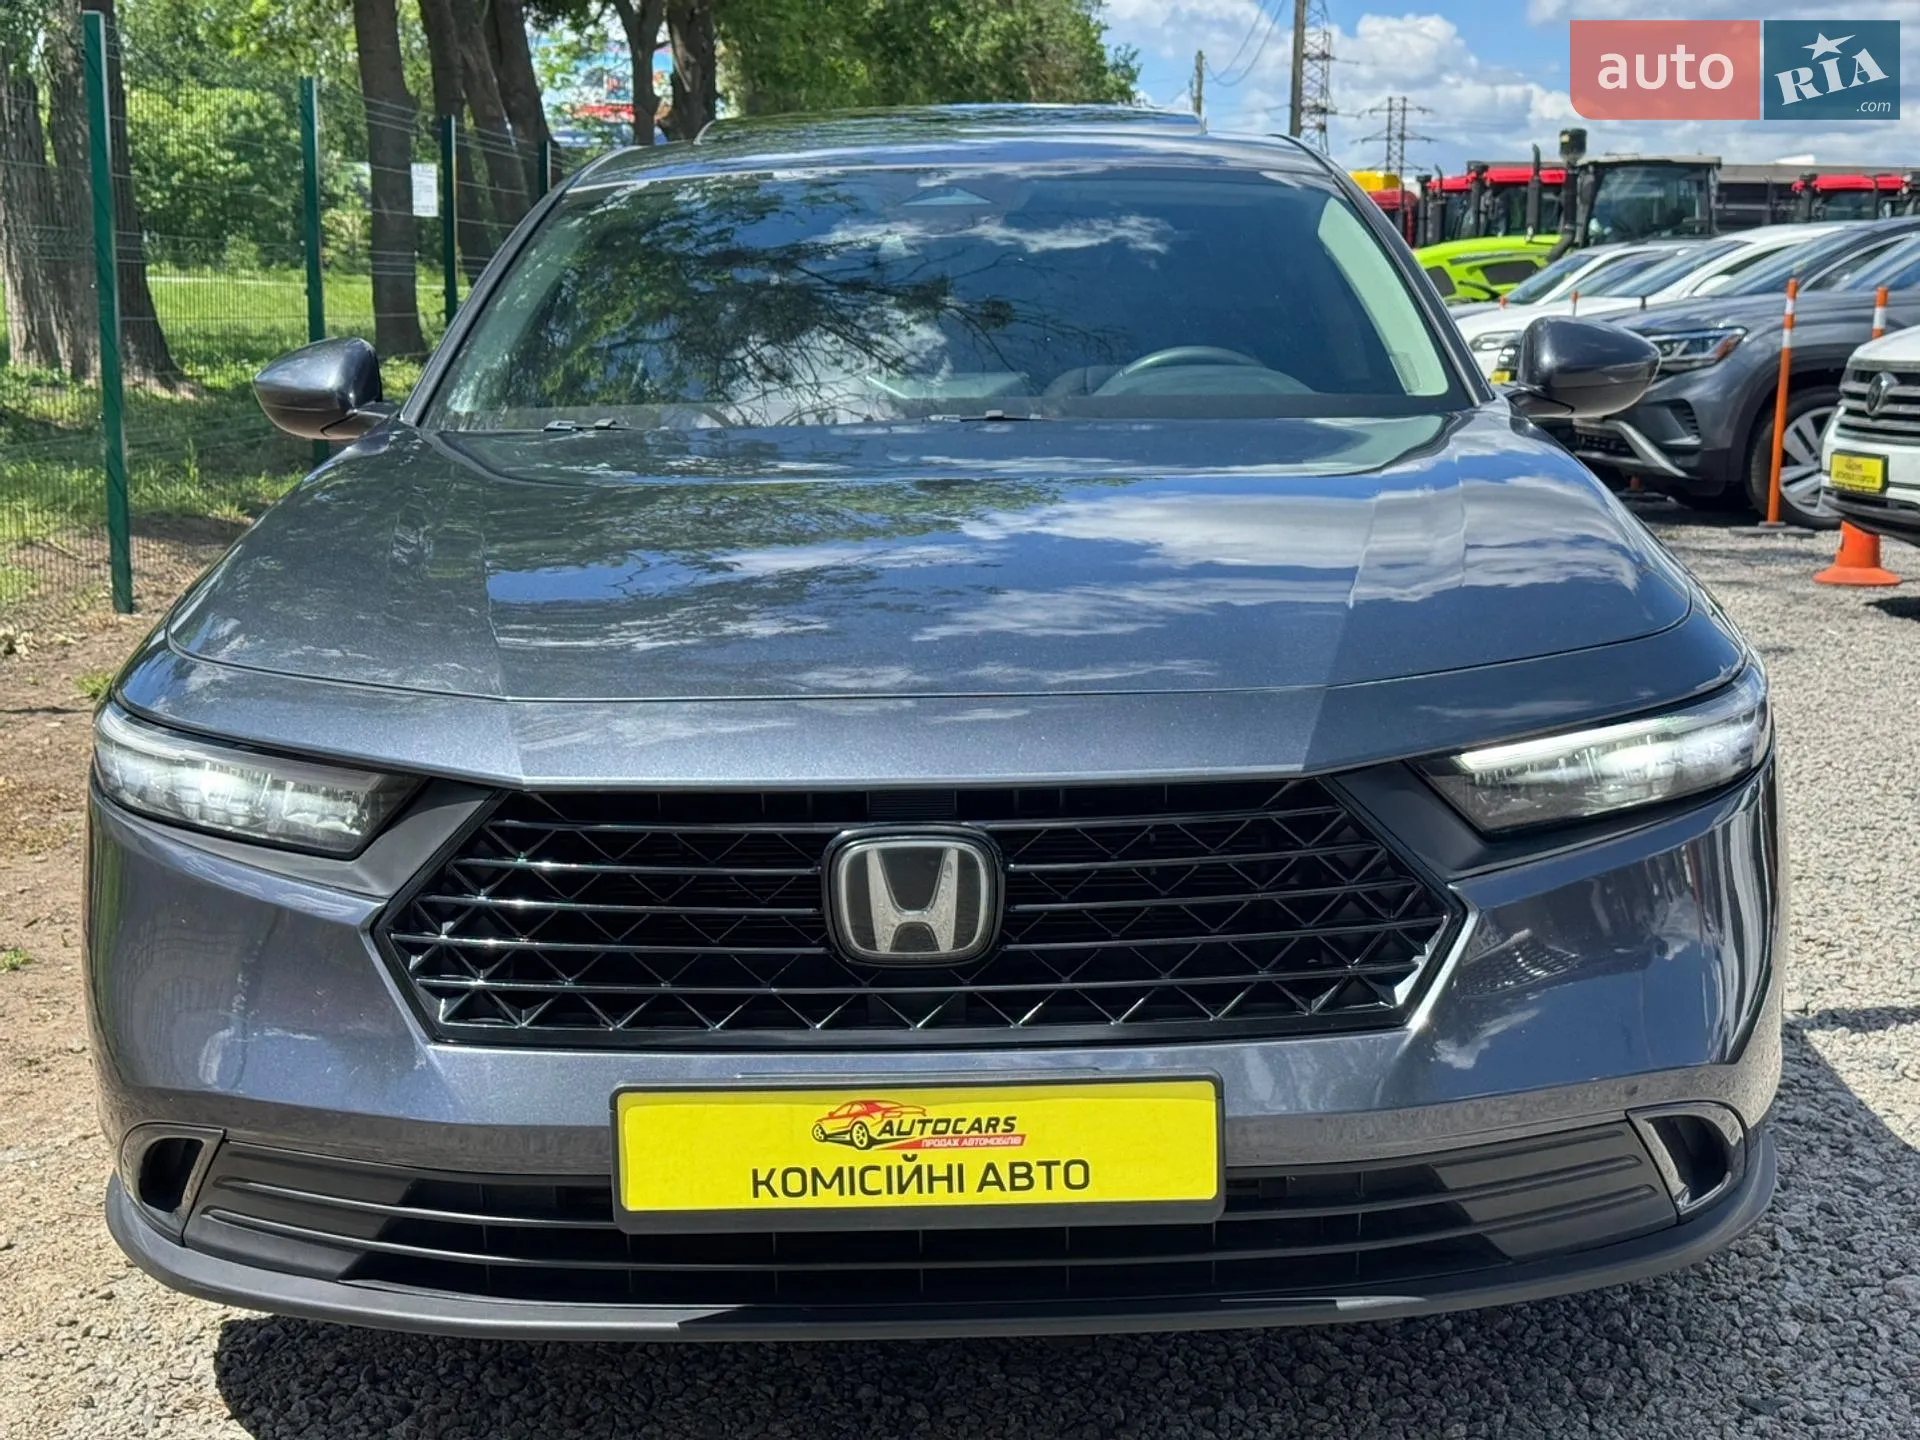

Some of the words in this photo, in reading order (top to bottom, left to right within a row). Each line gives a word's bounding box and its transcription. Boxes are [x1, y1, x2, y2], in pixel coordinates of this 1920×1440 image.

[877, 1115, 1017, 1138] AUTOCARS
[751, 1153, 965, 1199] КОМІСІЙНІ
[977, 1158, 1091, 1193] АВТО
